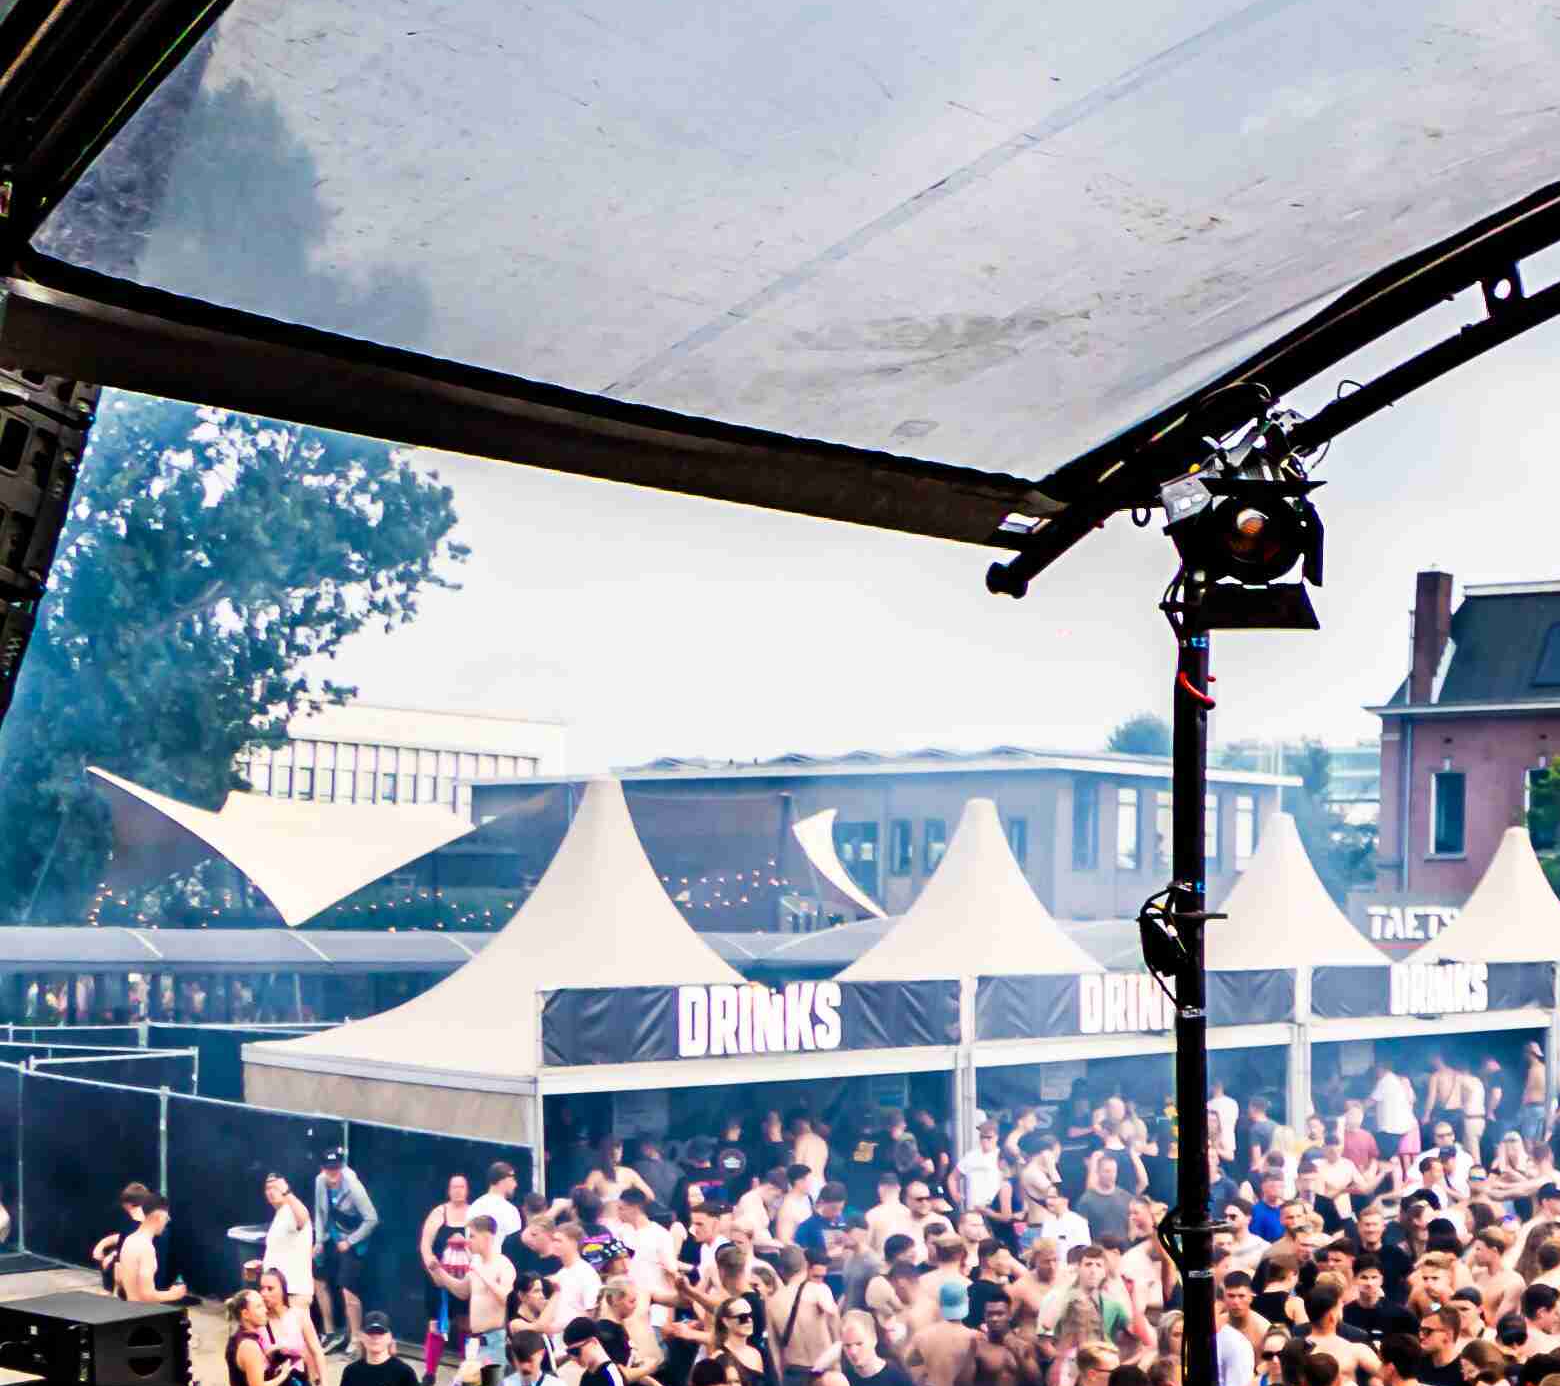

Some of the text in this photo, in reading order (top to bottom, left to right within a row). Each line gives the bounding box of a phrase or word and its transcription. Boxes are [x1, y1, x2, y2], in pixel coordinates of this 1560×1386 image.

[678, 982, 842, 1058] DRINKS
[1080, 972, 1177, 1034] DRIN
[1390, 963, 1488, 1016] DRINKS
